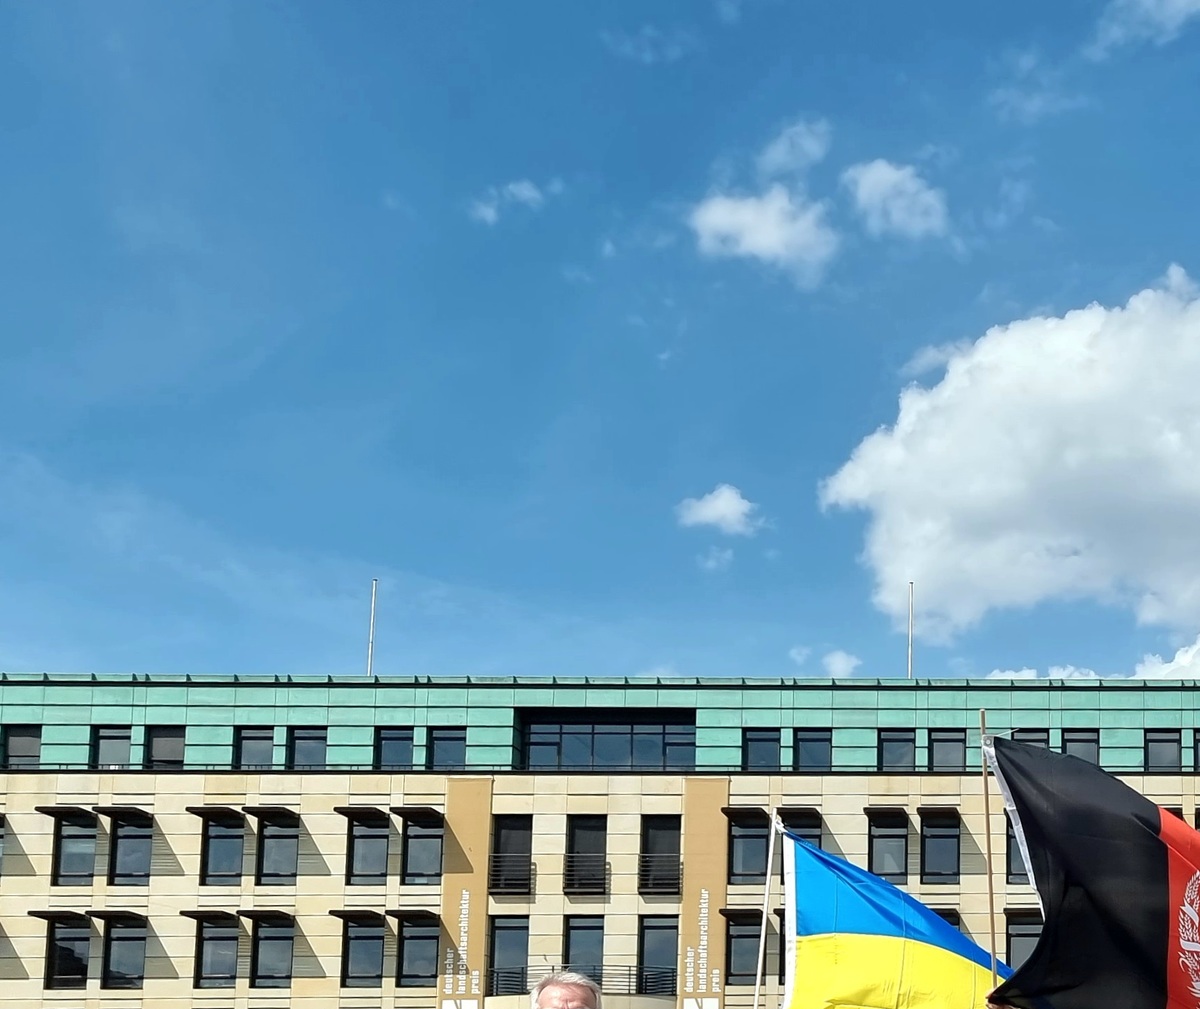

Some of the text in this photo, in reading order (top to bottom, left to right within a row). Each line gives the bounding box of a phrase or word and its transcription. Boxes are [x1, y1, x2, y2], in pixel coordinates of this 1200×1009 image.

[455, 889, 470, 995] landschaftsarchitektur
[696, 888, 709, 993] landschaftsarchitektur
[443, 947, 455, 995] deutscher
[469, 970, 482, 995] preis
[683, 946, 695, 993] deutscher
[709, 968, 722, 993] preis
